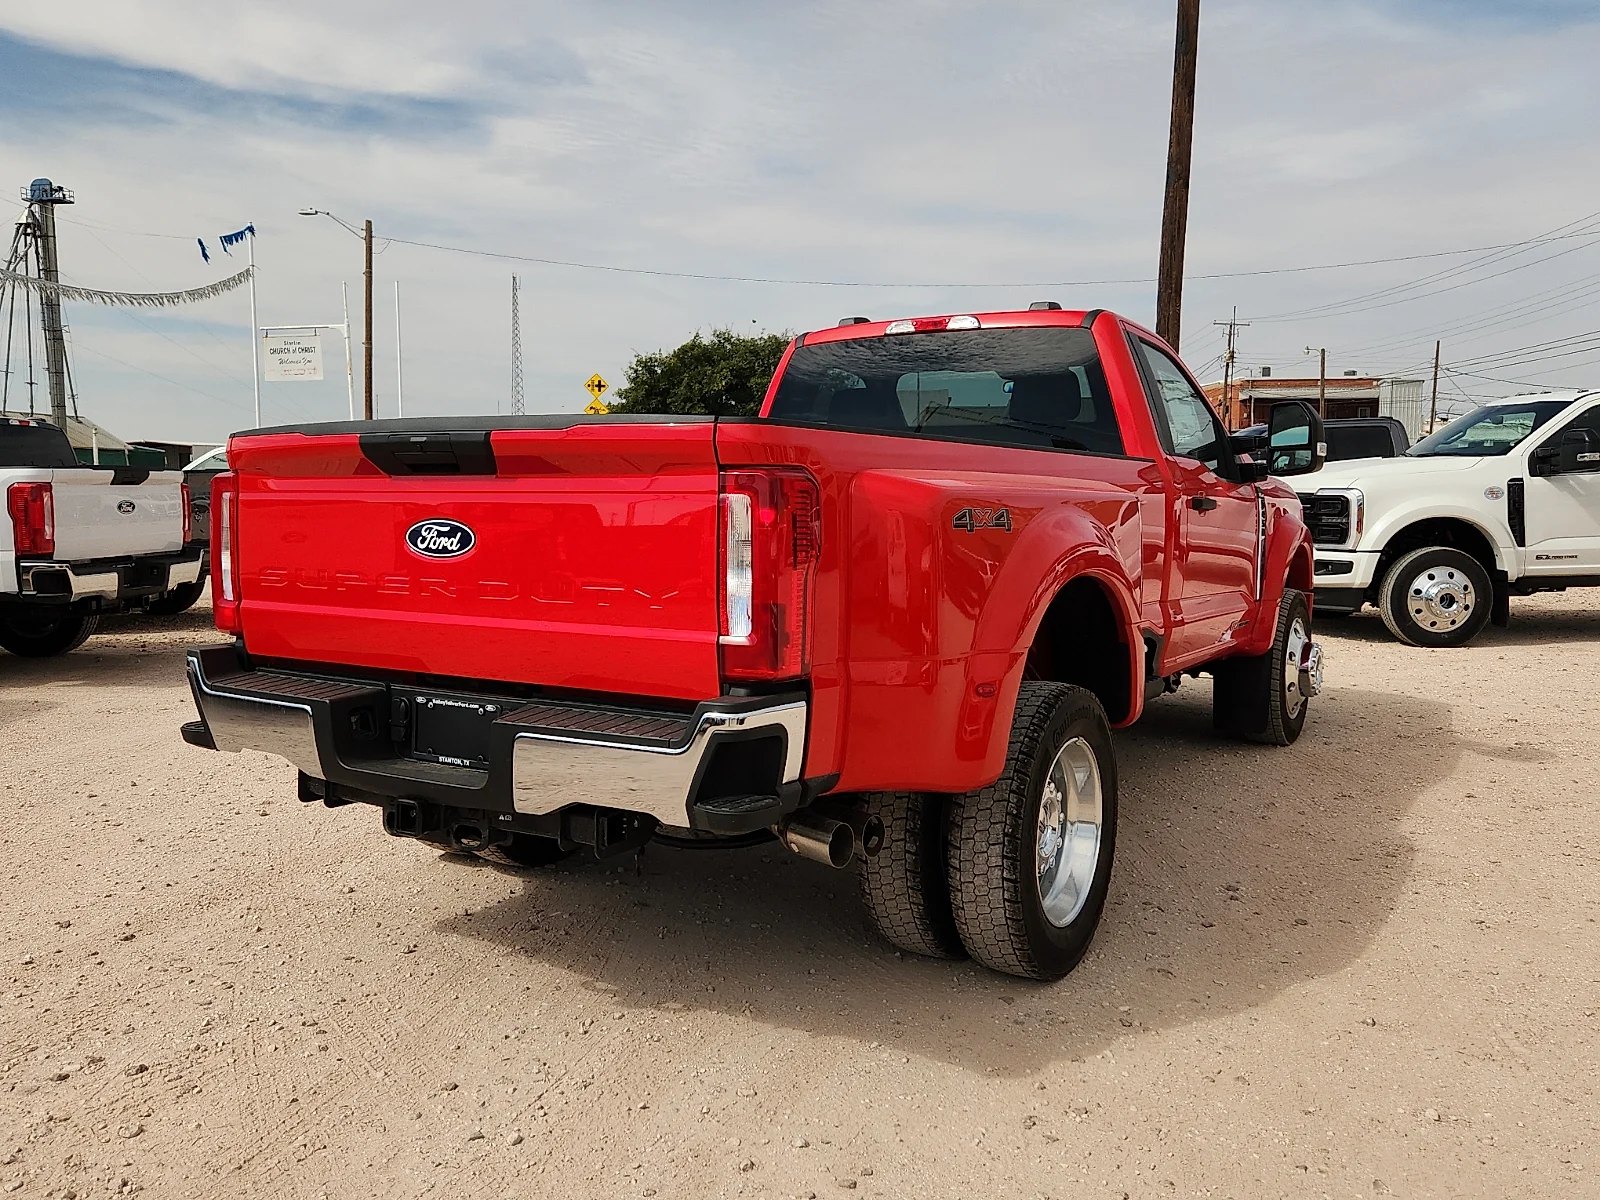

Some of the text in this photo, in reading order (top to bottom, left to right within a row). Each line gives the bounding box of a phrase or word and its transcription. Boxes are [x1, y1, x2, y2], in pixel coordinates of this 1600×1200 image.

[269, 347, 290, 355] CHURCH
[297, 346, 316, 354] CHRIST
[417, 524, 462, 551] Ford
[258, 566, 680, 609] SUPER DUTY
